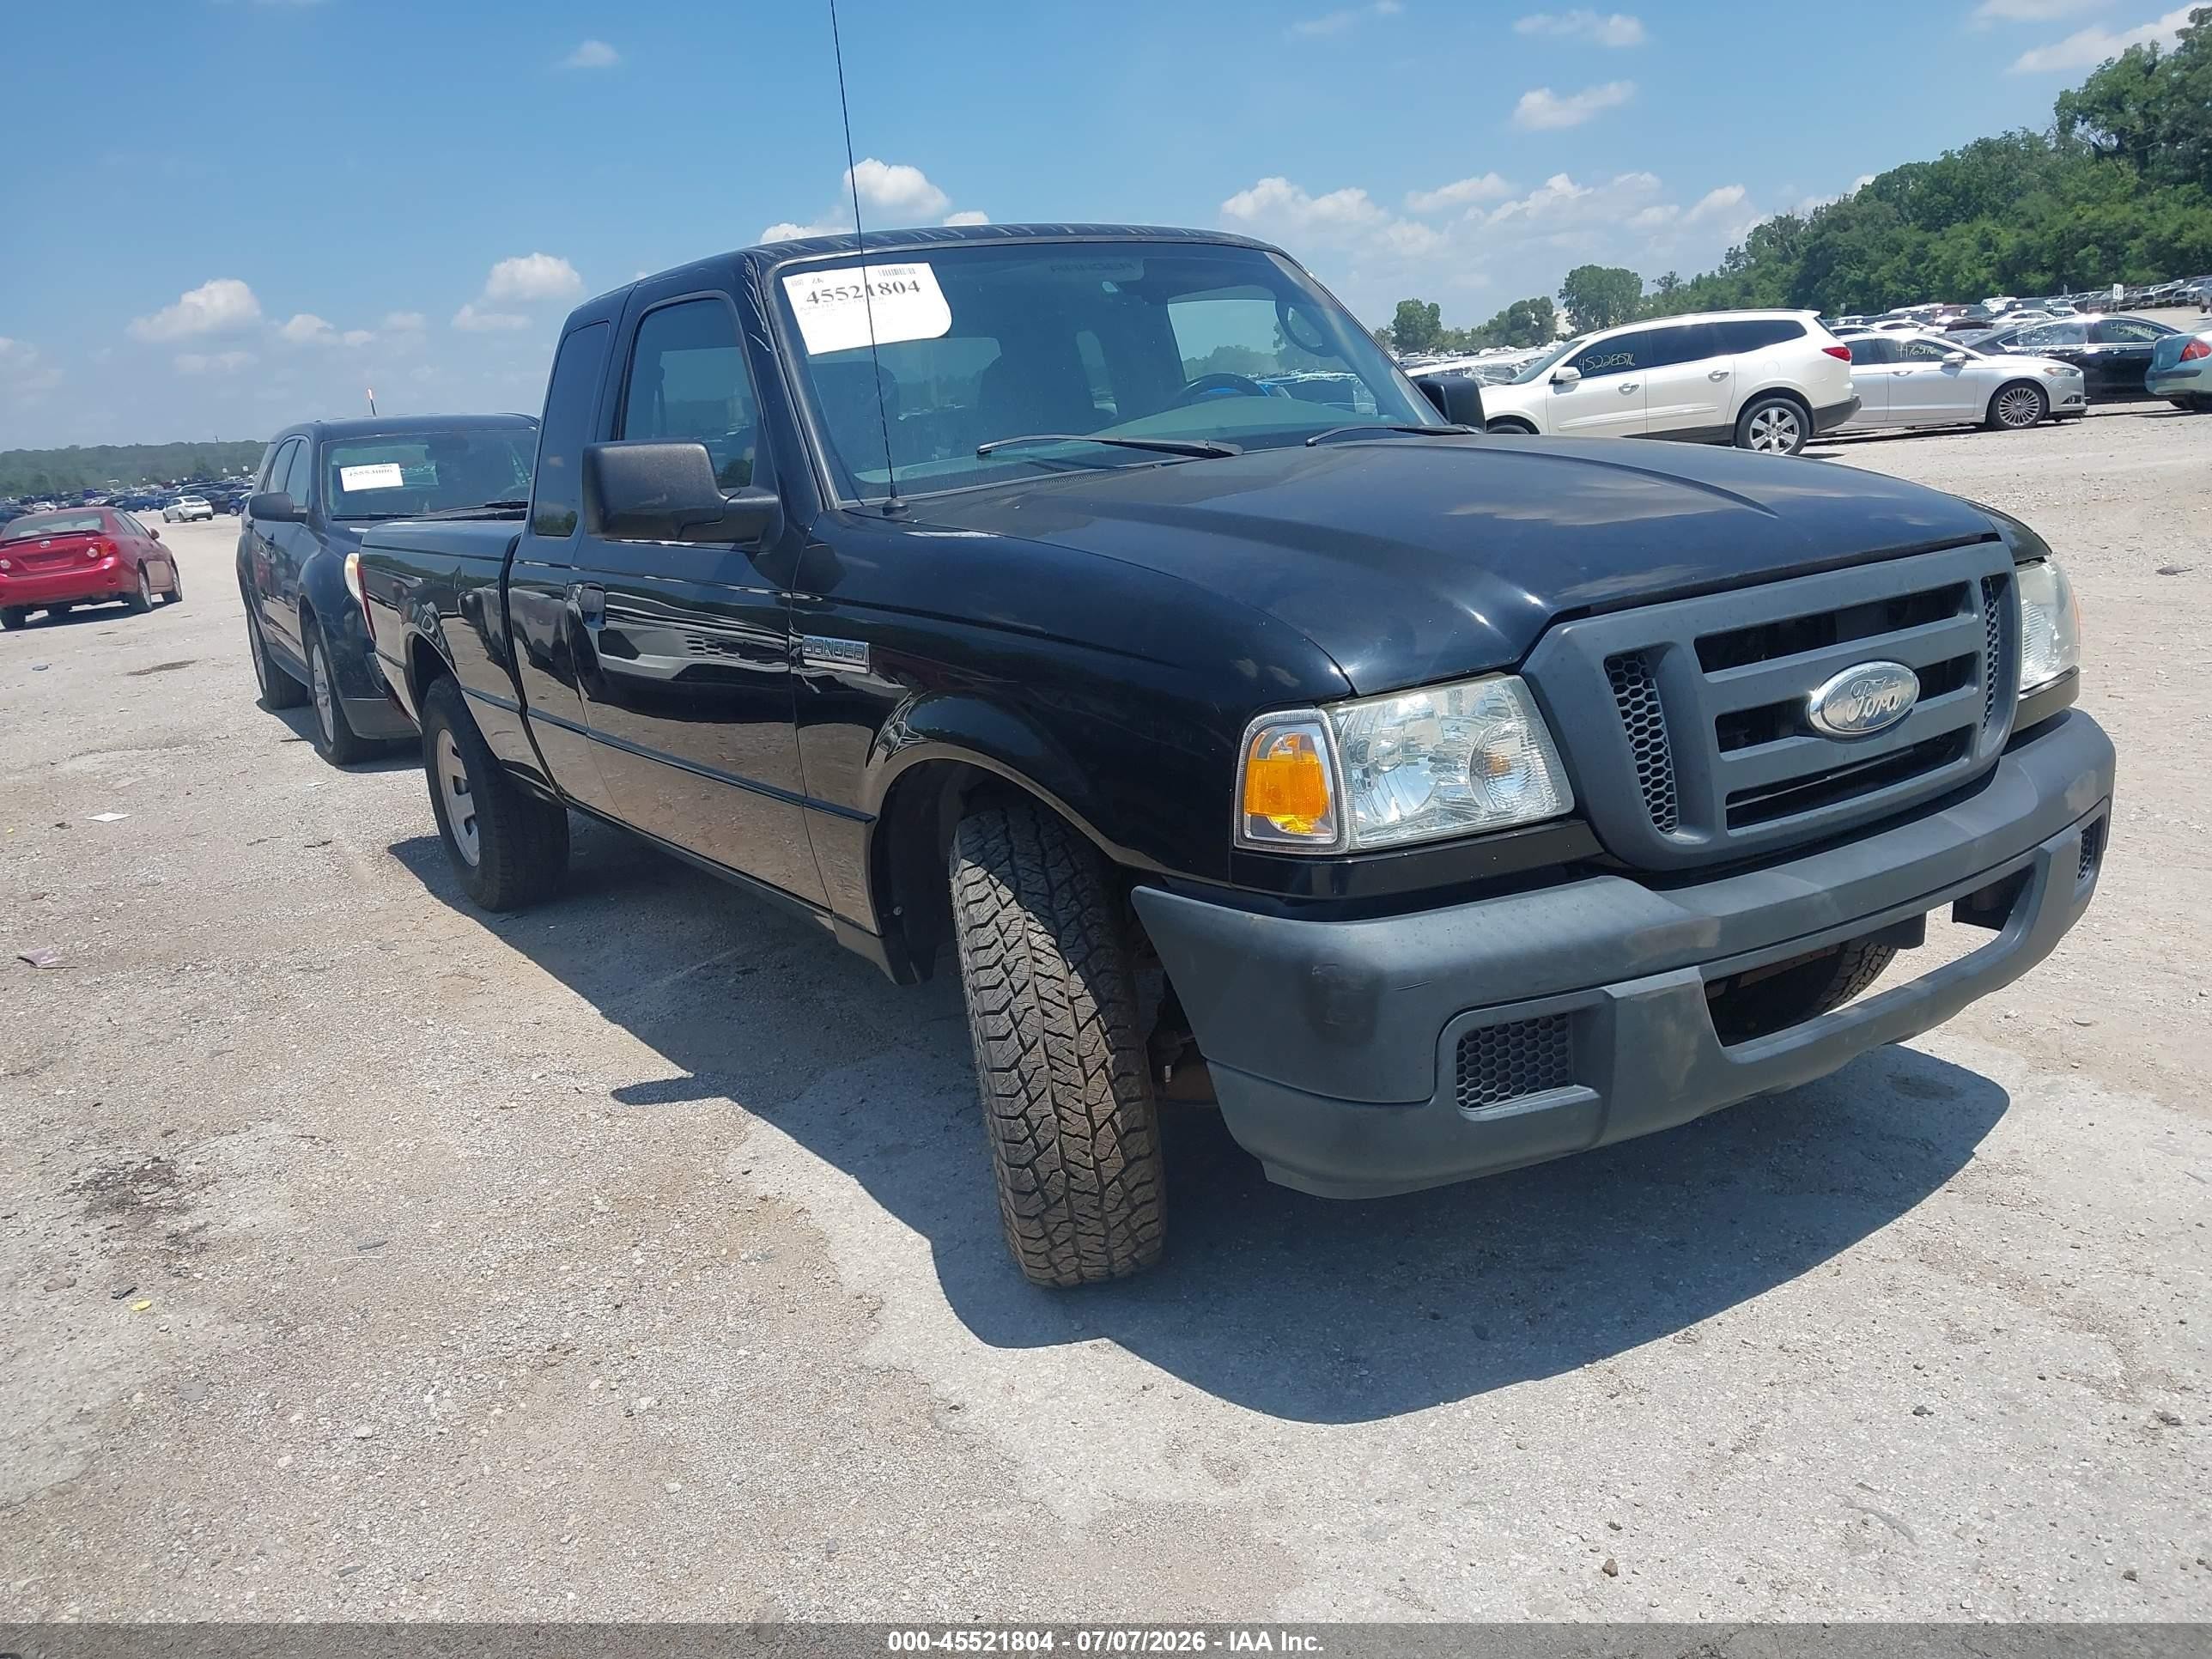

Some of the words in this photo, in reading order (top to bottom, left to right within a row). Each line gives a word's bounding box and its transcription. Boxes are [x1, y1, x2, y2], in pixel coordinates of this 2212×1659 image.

[806, 280, 921, 304] 45521804
[804, 638, 866, 660] RANGER
[1845, 677, 1901, 722] Ford
